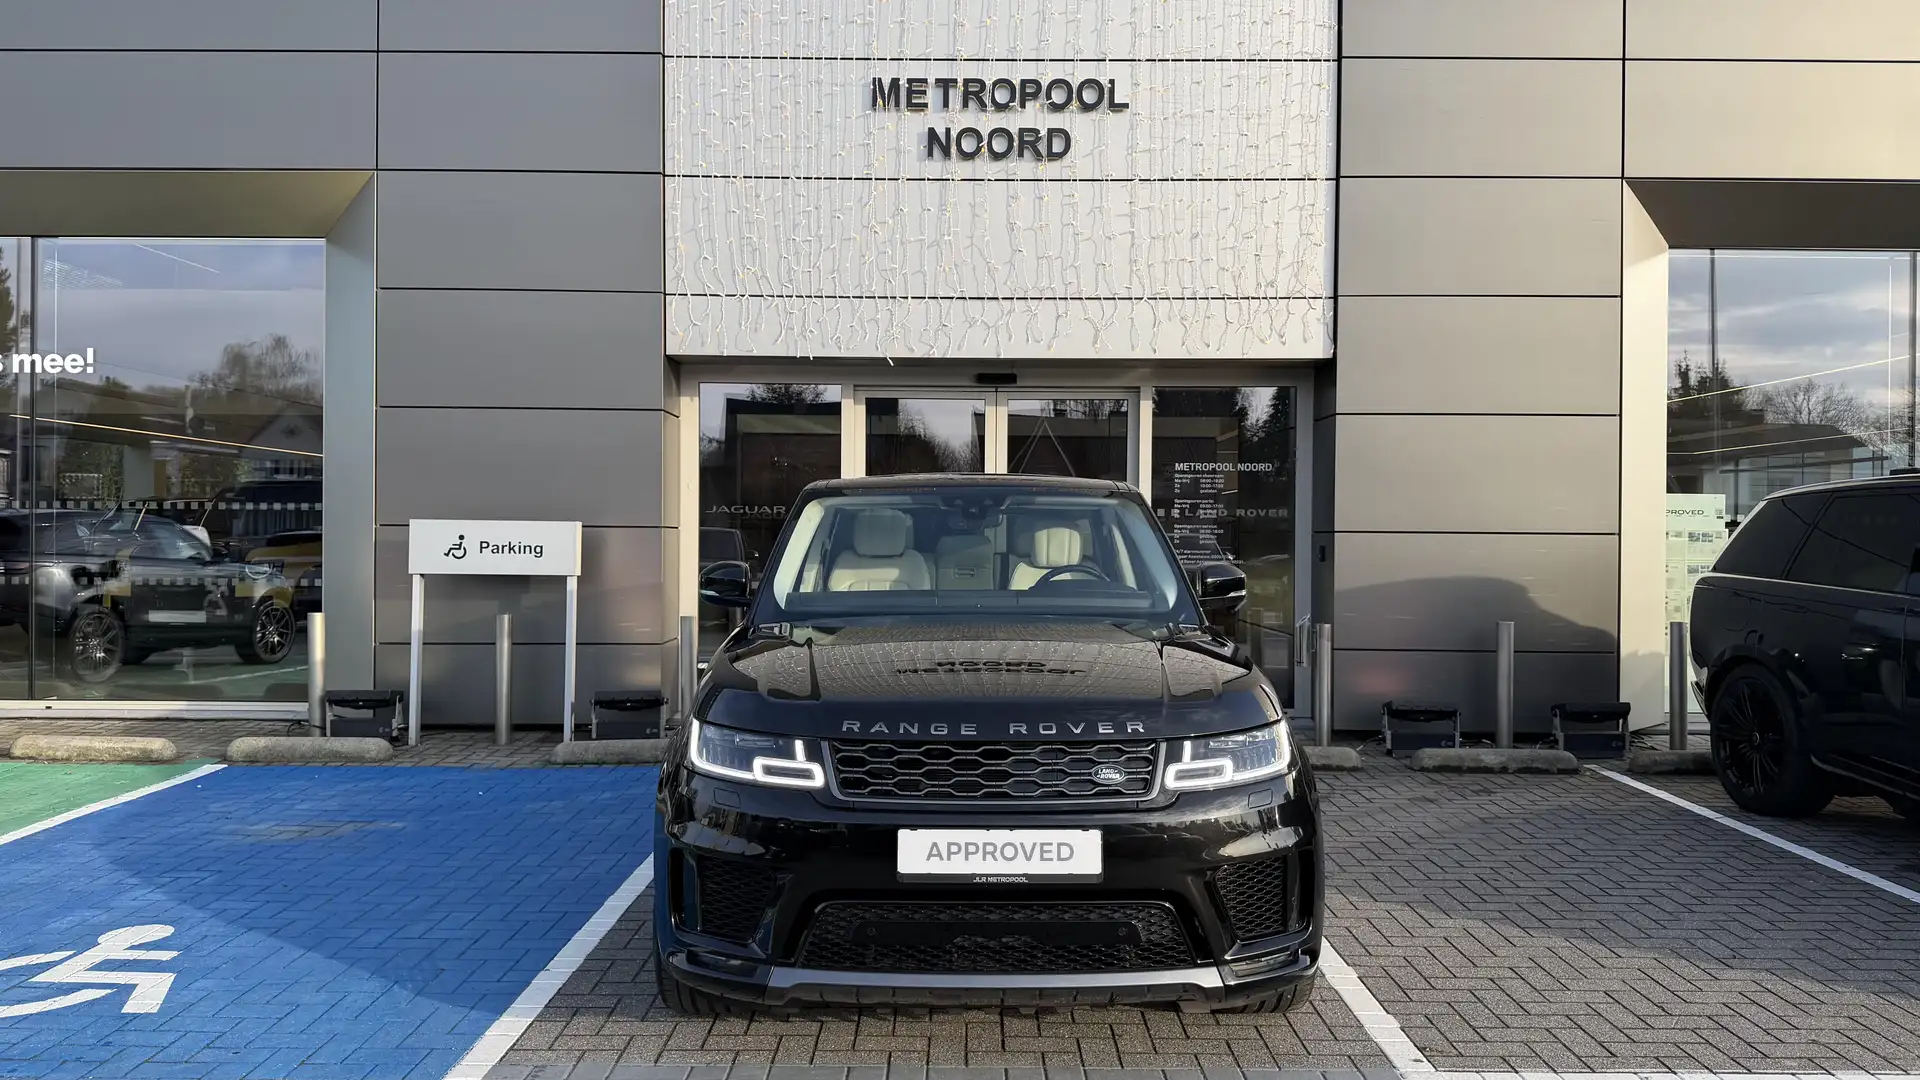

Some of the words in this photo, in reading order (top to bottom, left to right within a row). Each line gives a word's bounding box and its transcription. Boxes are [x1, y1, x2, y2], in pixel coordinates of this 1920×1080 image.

[872, 77, 1129, 110] METROPOOL
[927, 127, 1072, 160] NOORD
[12, 347, 94, 374] mee!
[1174, 462, 1236, 471] METROPOOL
[1237, 463, 1273, 472] NOORD
[705, 505, 786, 513] JAGUAR
[1236, 508, 1288, 517] ROVER
[479, 540, 544, 558] Parking
[841, 720, 977, 735] RANGE
[1009, 721, 1145, 735] ROVER
[925, 841, 1075, 862] APPROVED
